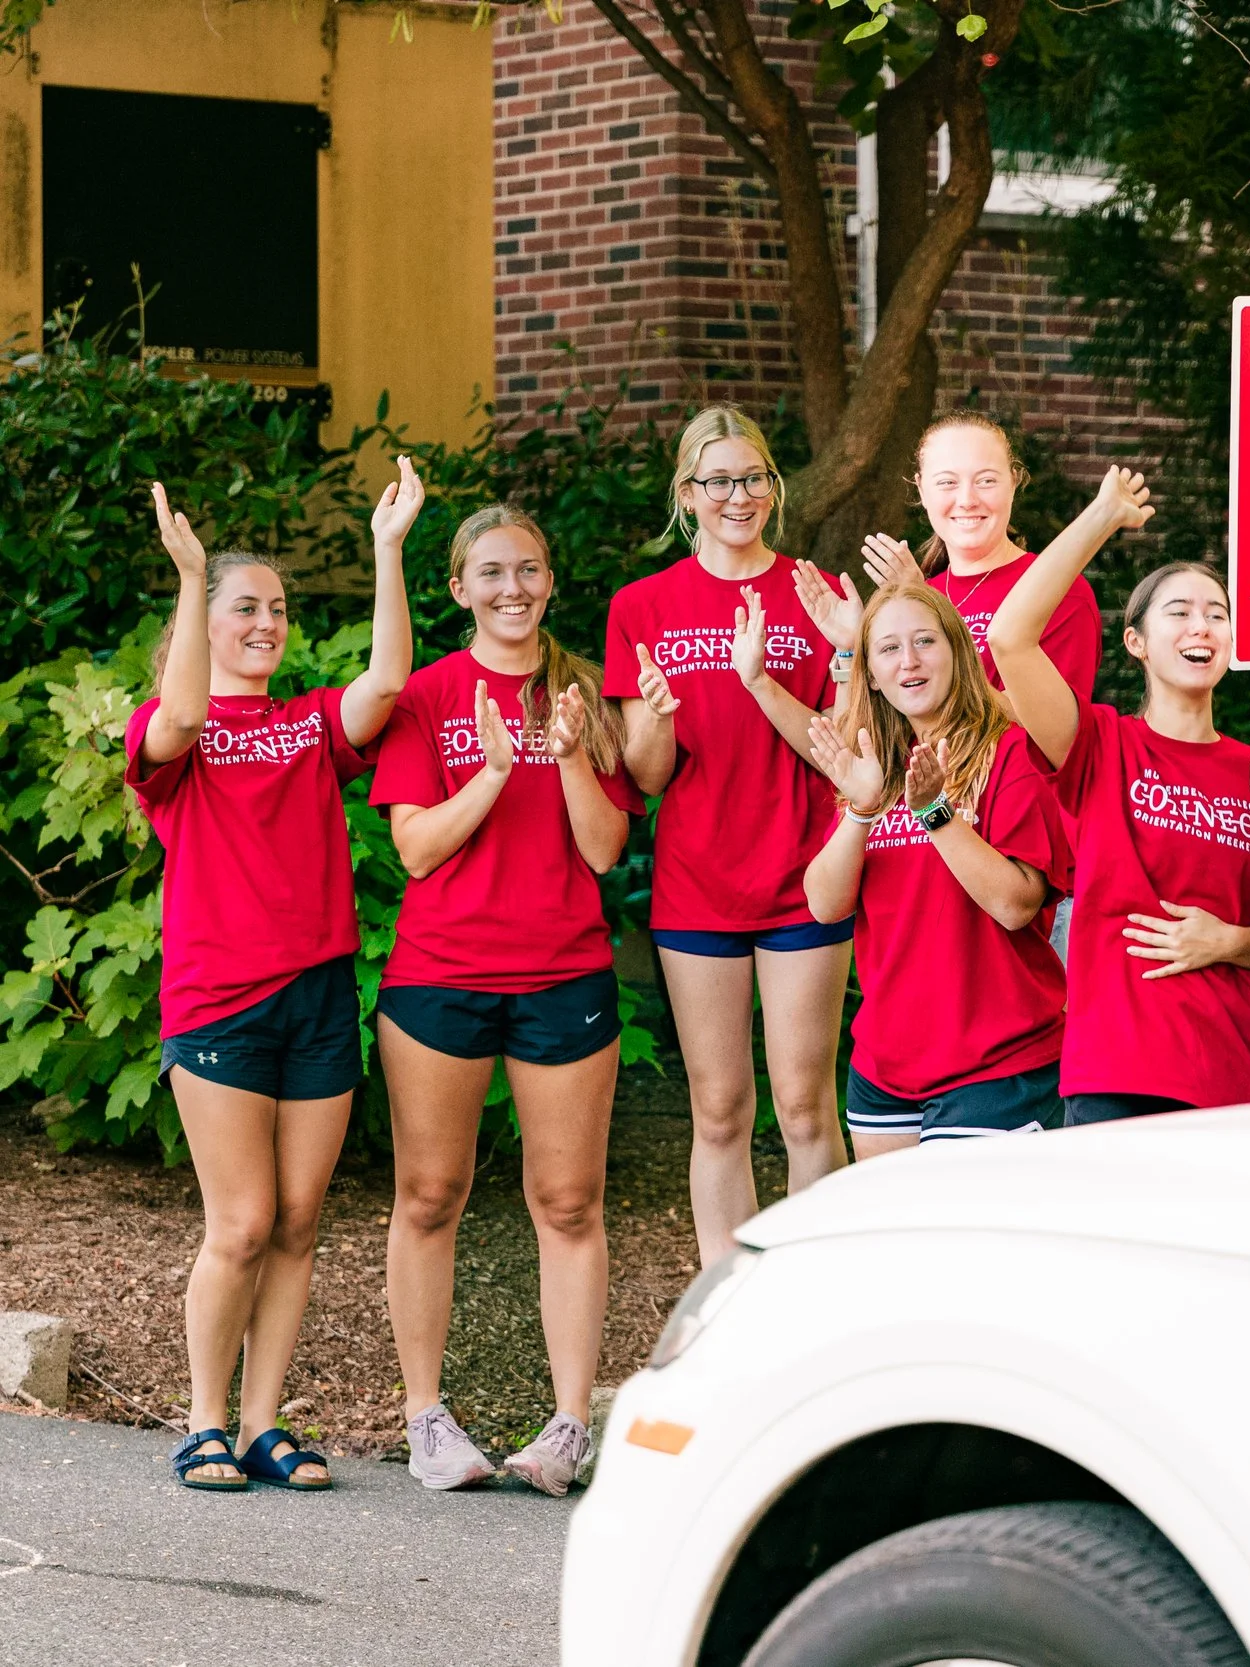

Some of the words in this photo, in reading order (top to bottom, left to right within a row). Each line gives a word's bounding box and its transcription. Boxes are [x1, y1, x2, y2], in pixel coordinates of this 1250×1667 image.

[765, 625, 795, 633] LEGE
[655, 636, 807, 666] CONNCT
[765, 660, 794, 671] KEND
[444, 718, 520, 729] MUHLRG
[447, 753, 519, 768] ORIENTN
[525, 755, 557, 764] WEEK
[1133, 809, 1211, 841] ORIENTATION
